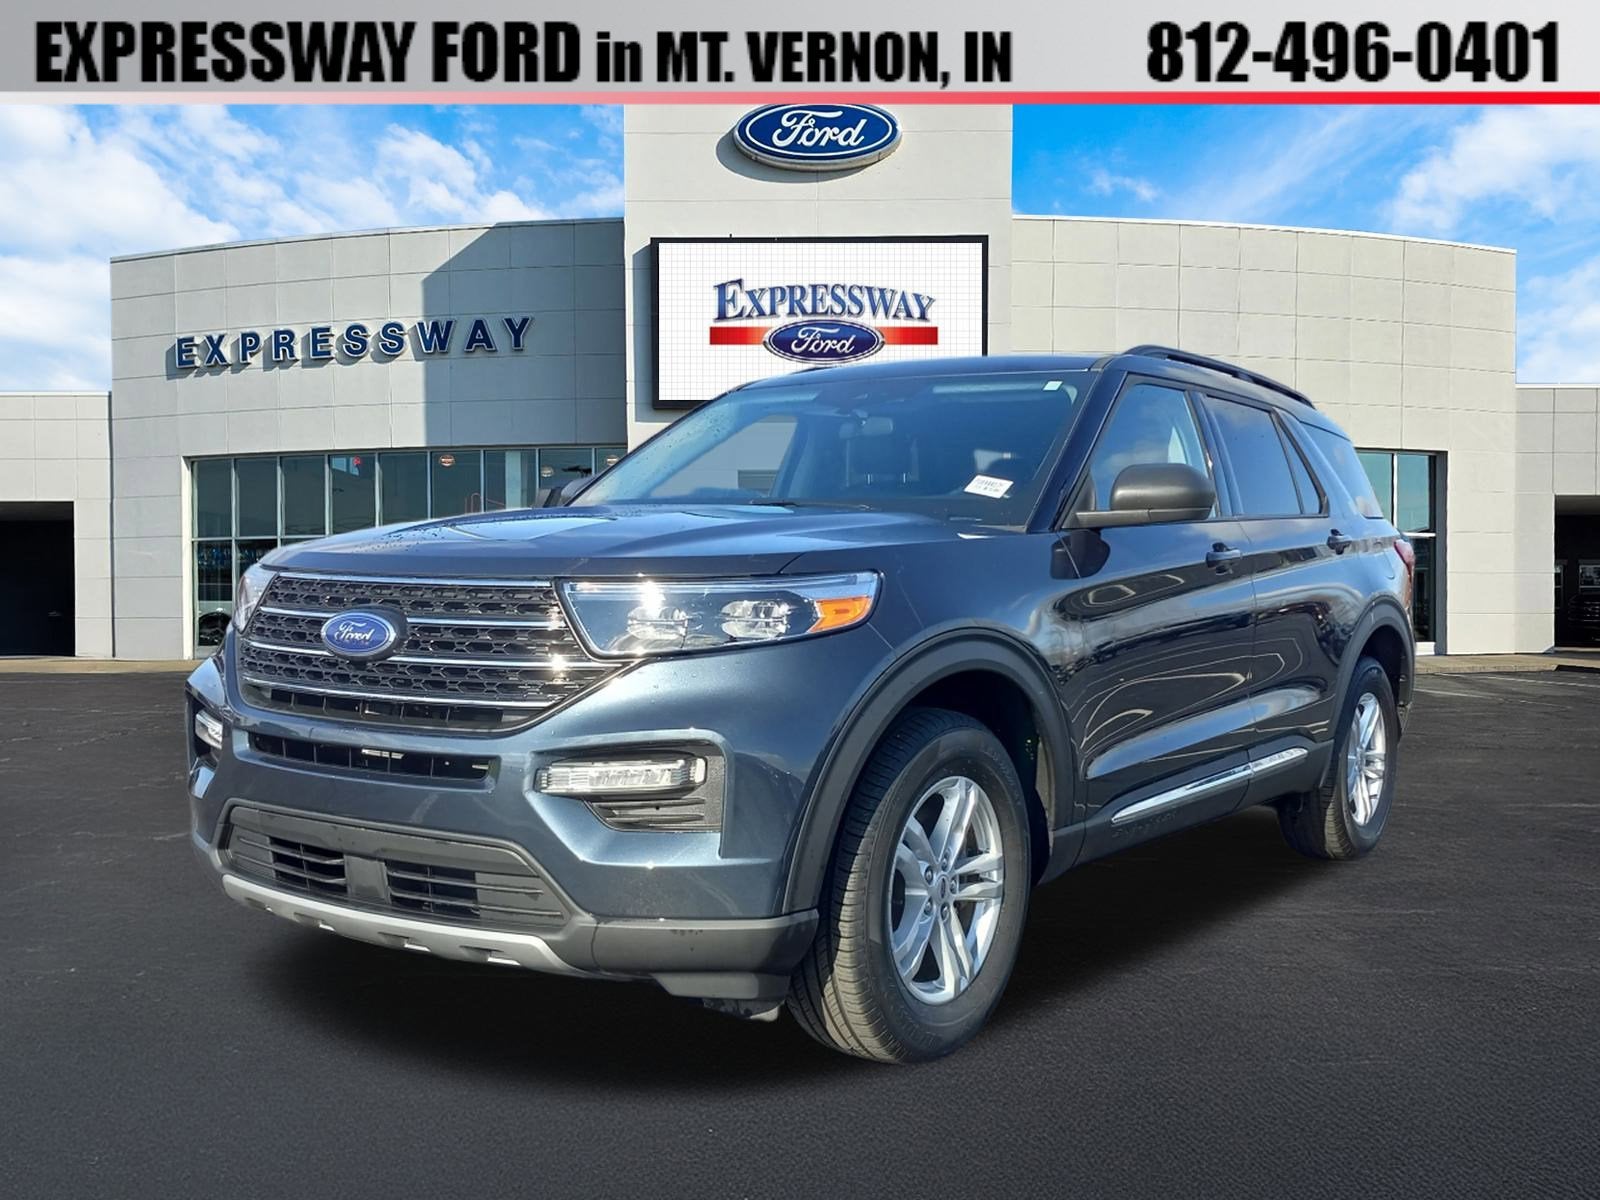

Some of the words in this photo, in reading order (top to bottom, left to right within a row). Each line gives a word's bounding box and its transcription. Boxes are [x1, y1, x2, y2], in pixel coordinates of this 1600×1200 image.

[771, 109, 868, 147] Ford
[713, 278, 936, 322] EXPRESSWAY
[175, 316, 533, 369] EXPRESSWAY
[790, 326, 855, 354] Ford
[334, 620, 376, 642] Ford
